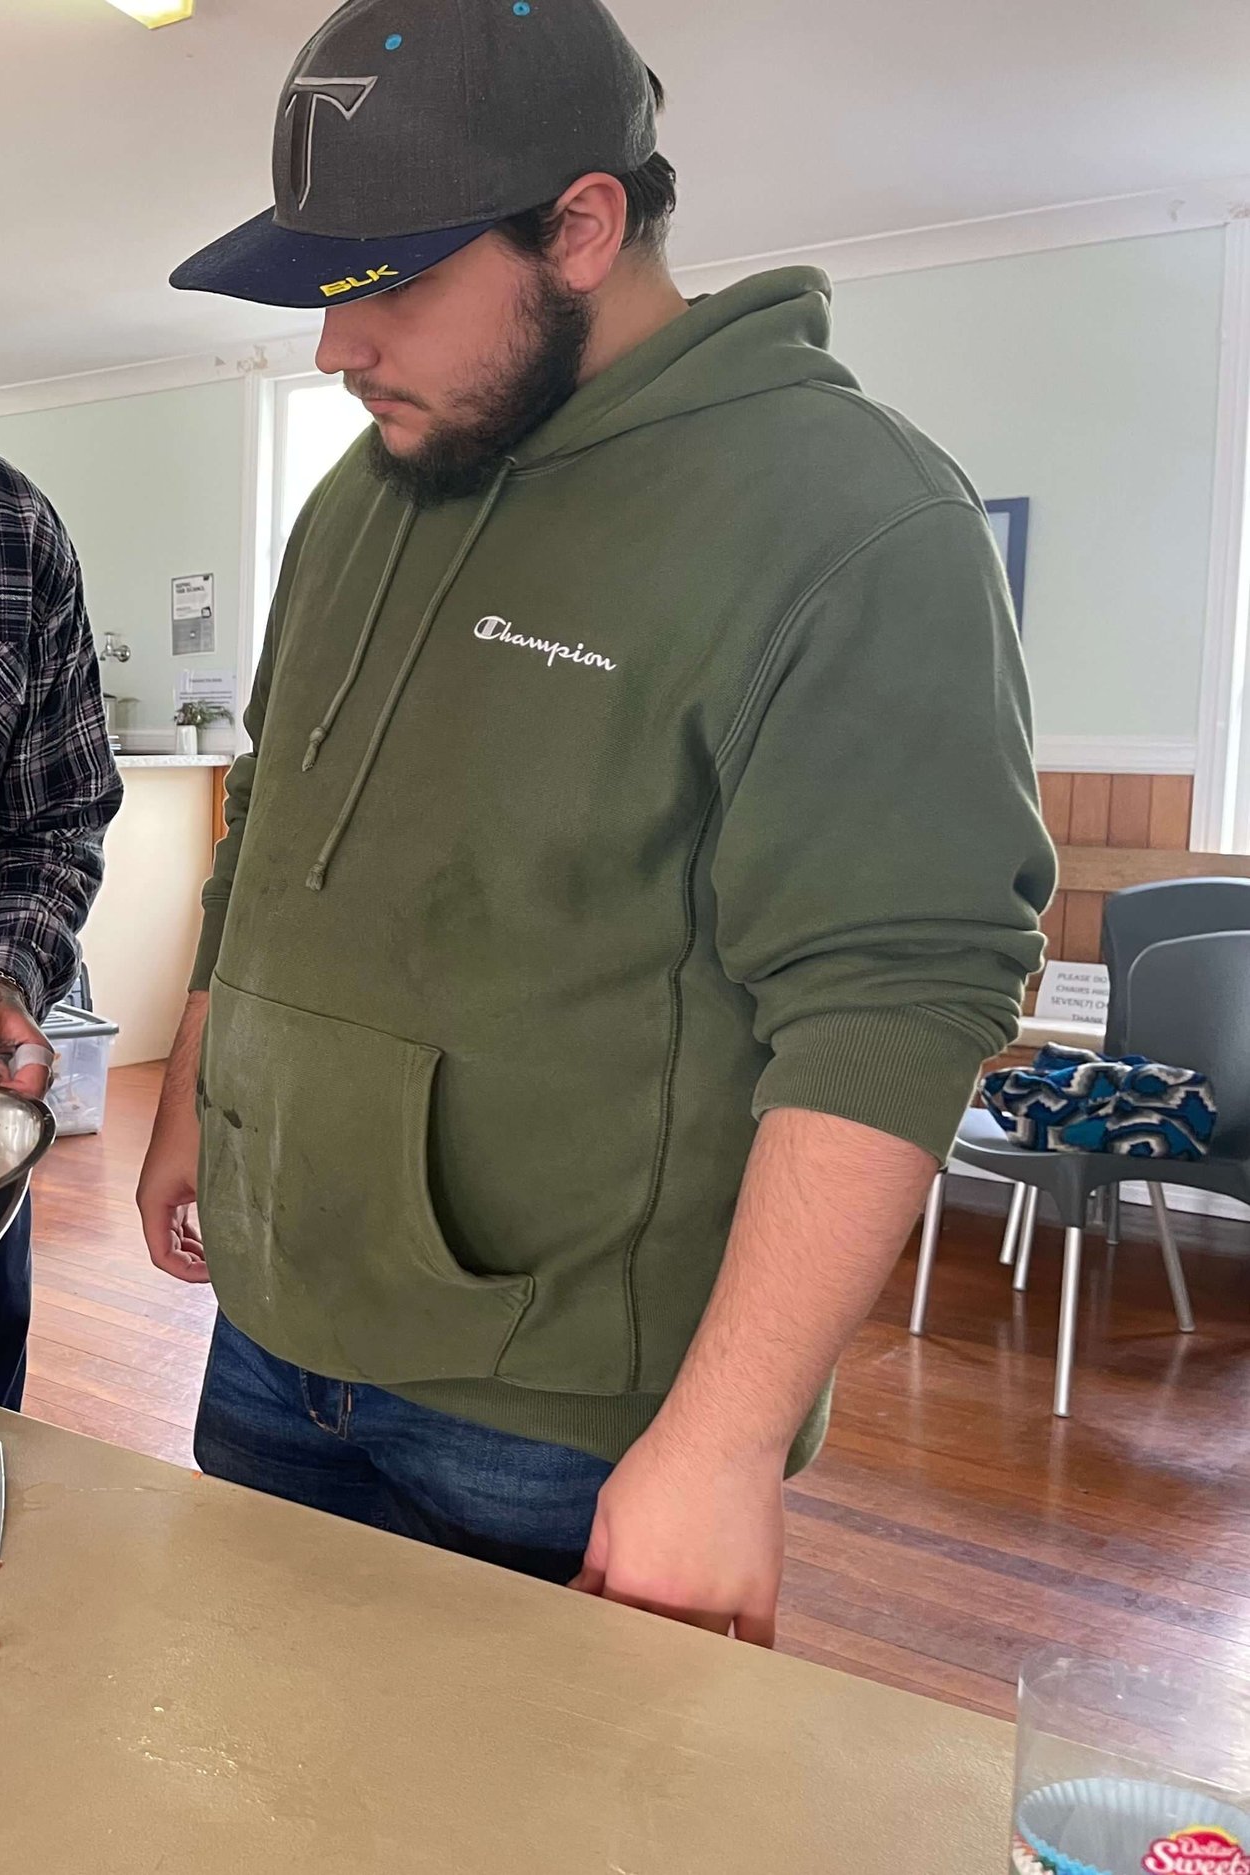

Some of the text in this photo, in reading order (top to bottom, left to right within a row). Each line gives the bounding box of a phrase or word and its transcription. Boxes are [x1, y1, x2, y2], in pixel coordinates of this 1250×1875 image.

[319, 264, 400, 297] BLK
[473, 615, 618, 671] Champion
[1057, 973, 1091, 981] PLEASE
[1056, 985, 1091, 994] CHAIRS
